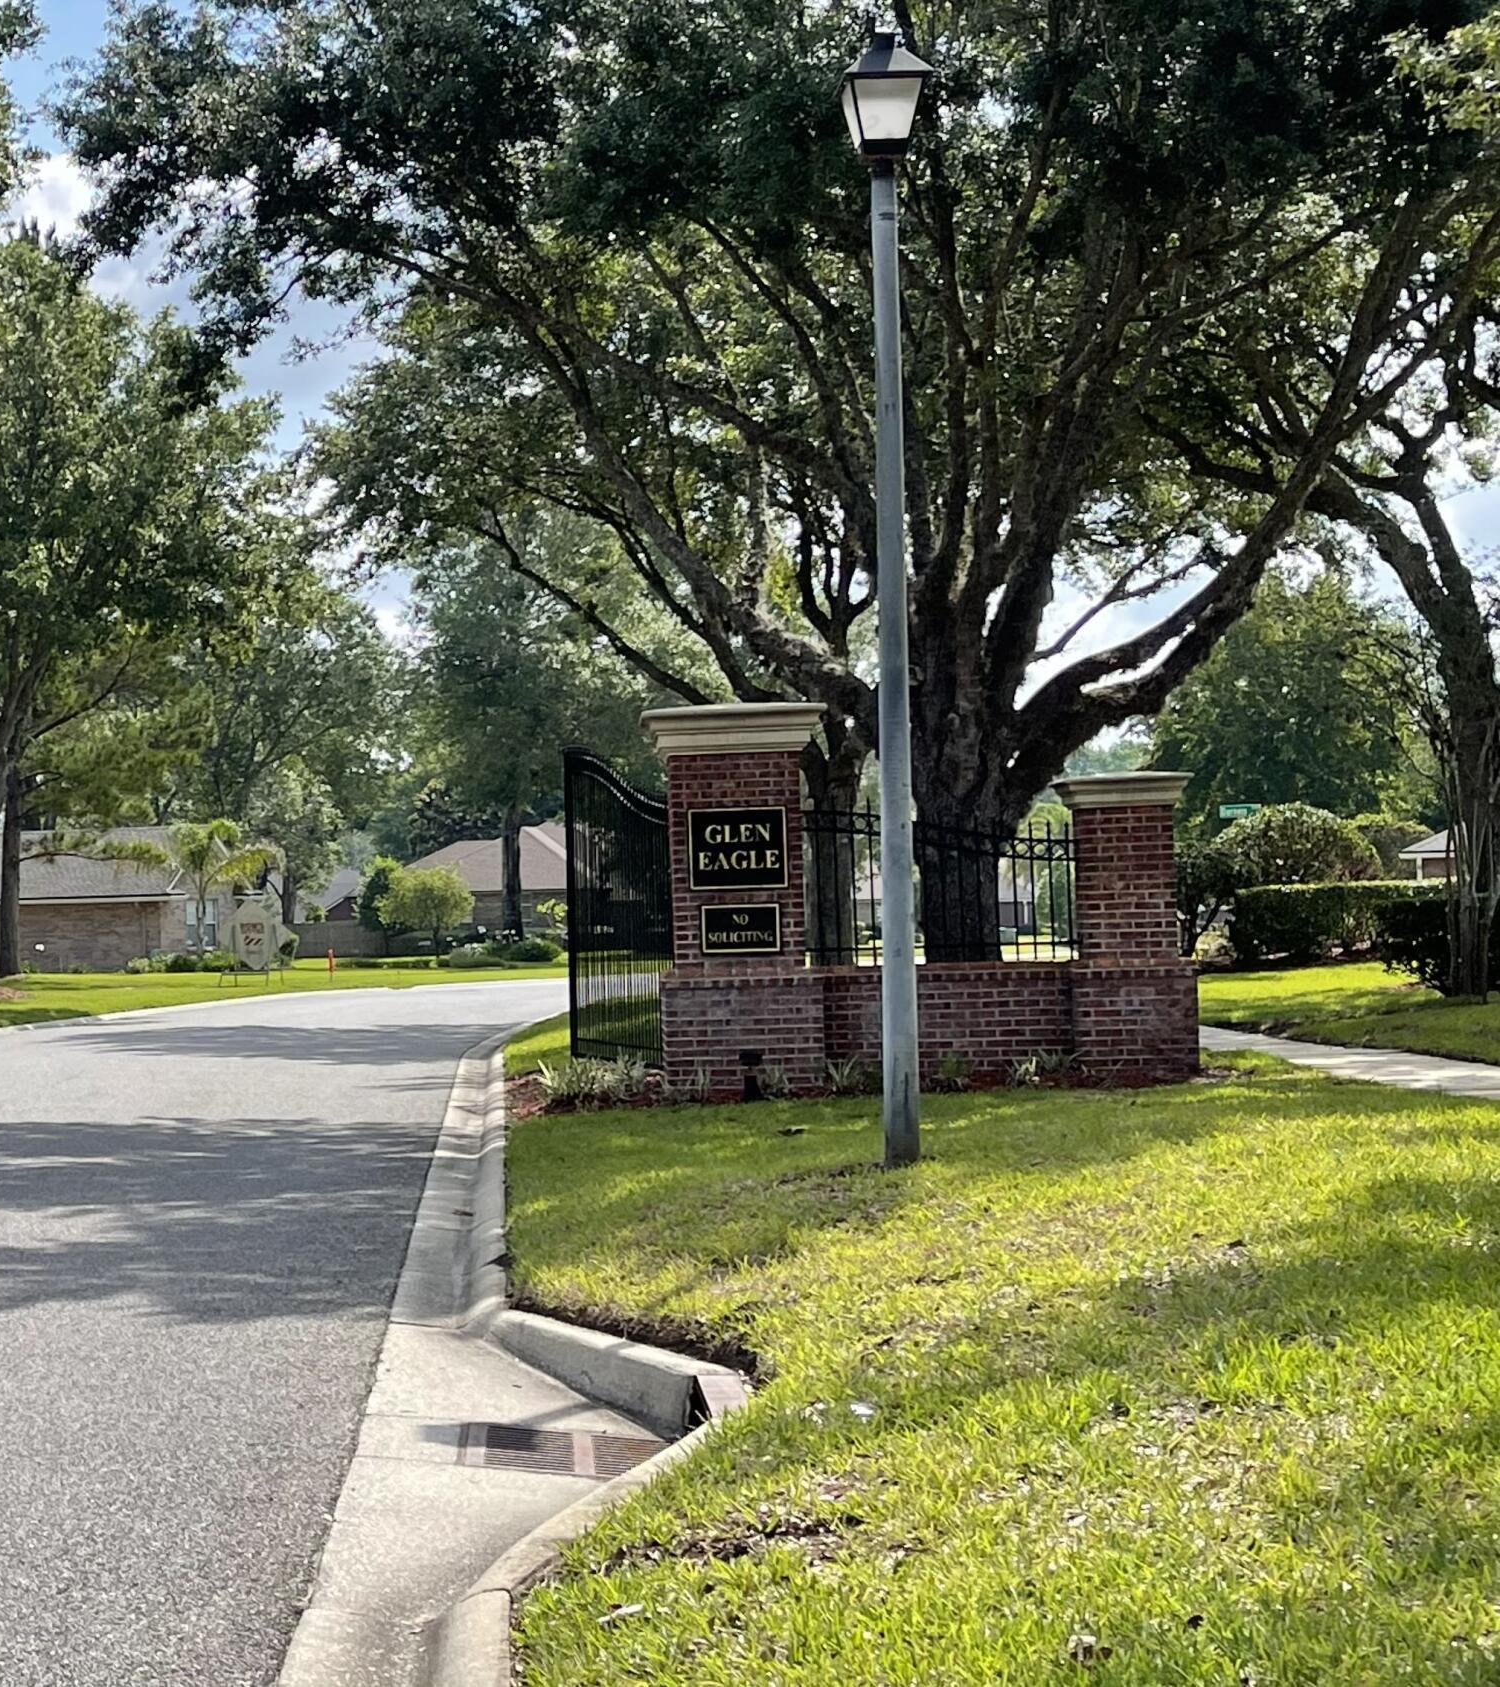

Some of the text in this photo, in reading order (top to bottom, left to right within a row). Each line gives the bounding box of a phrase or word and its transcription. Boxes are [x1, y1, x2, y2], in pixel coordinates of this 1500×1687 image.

[705, 824, 770, 843] GLEN
[698, 850, 780, 870] EAGLE
[733, 914, 748, 925] NO
[708, 930, 774, 943] SOLICITING
